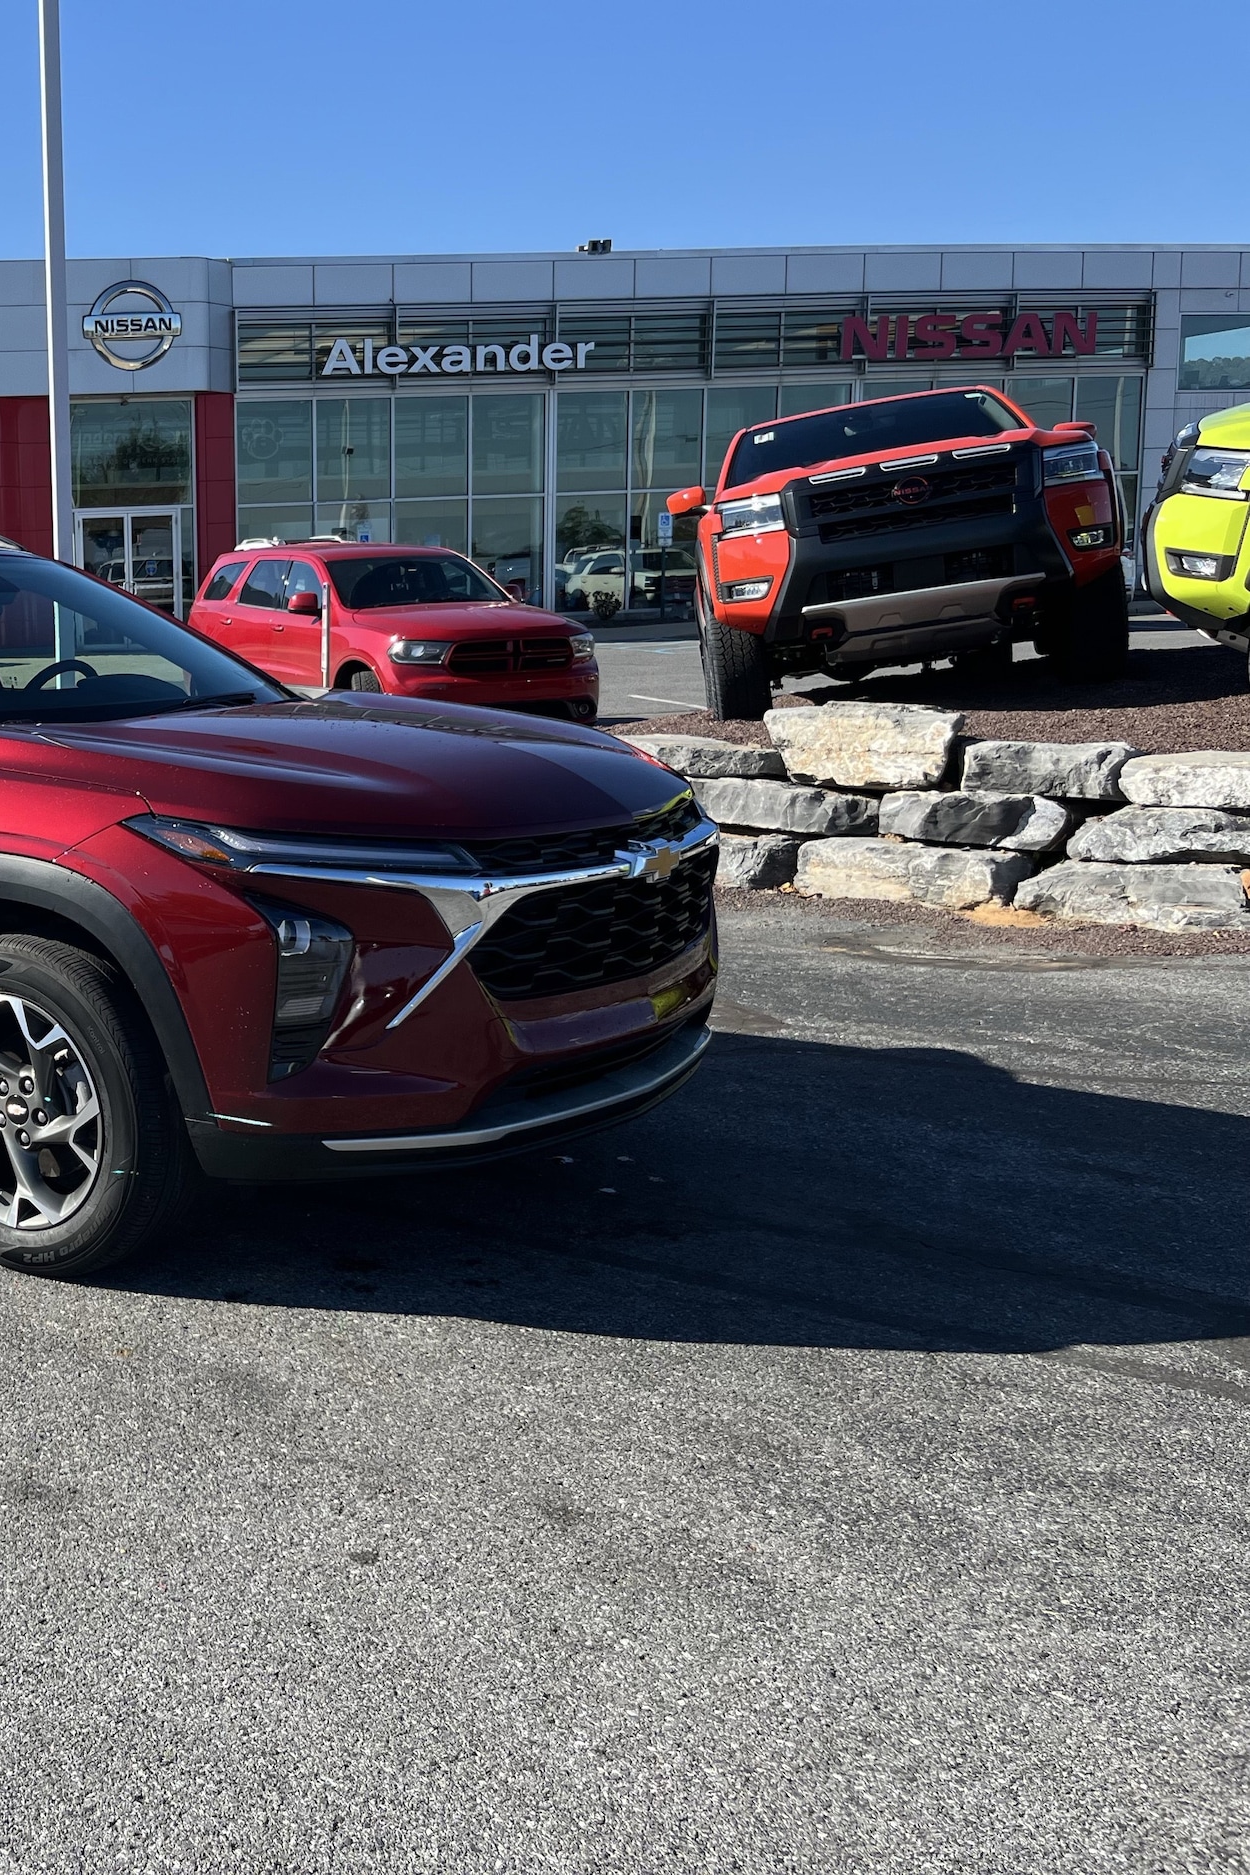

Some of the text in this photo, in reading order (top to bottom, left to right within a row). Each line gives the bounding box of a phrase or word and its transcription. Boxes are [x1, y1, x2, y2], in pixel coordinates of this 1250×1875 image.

[94, 317, 172, 333] NISSAN
[840, 311, 1098, 360] NISSAN
[321, 334, 595, 376] Alexander
[894, 486, 933, 496] NISSAN
[22, 1251, 56, 1264] HP2
